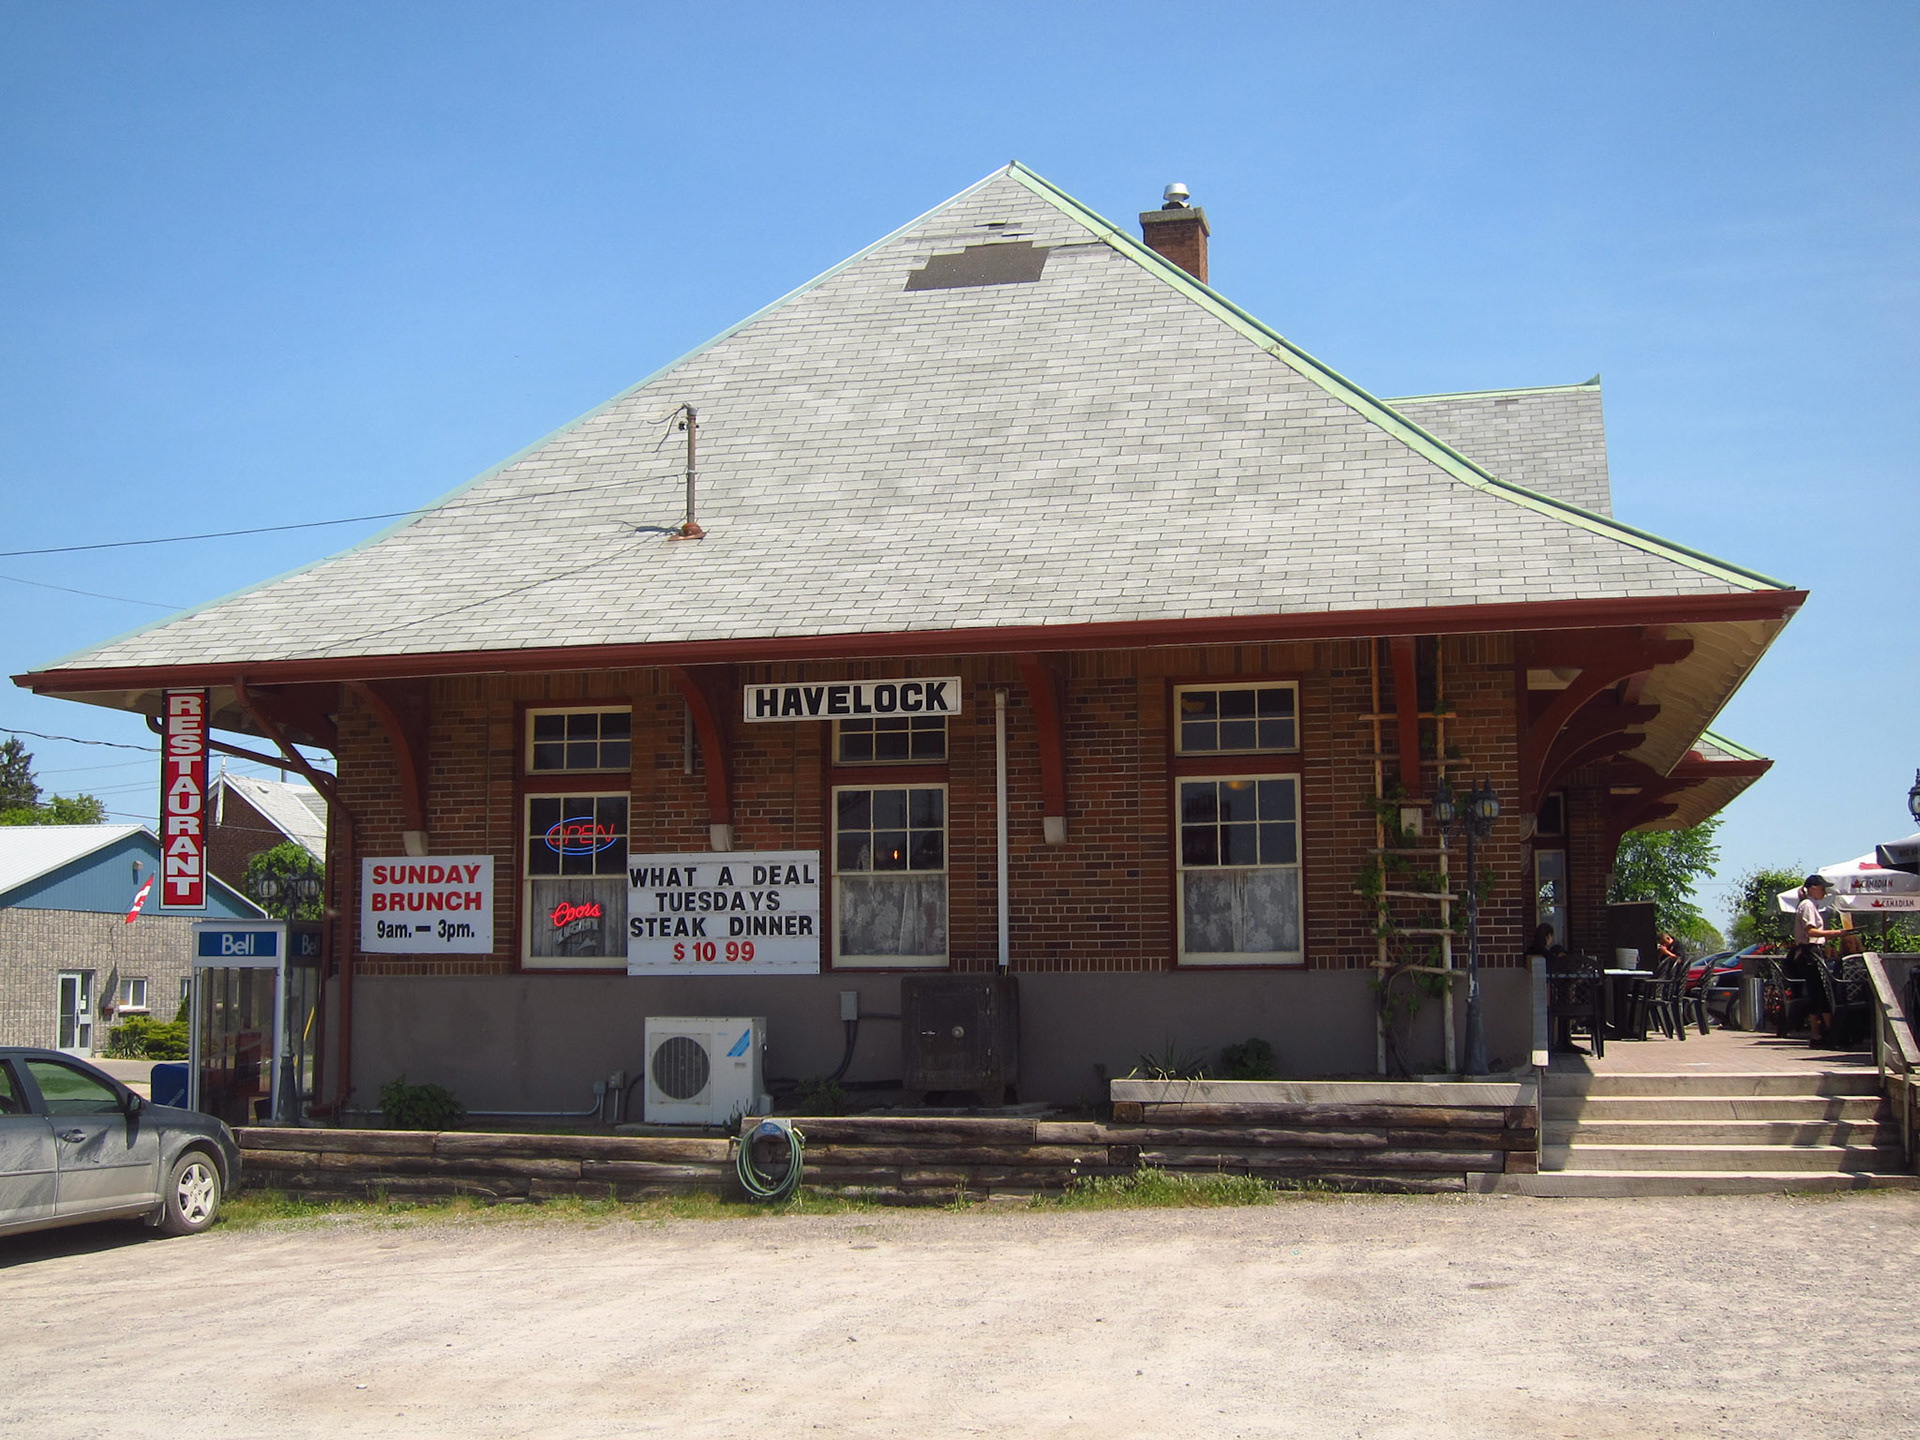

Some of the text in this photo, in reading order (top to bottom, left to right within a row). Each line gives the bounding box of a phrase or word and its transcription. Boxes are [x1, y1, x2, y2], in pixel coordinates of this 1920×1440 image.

[755, 682, 949, 717] HAVELOCK
[166, 696, 202, 896] RESTAURANT
[548, 824, 615, 846] OPEN
[372, 864, 481, 885] SUNDAY
[629, 864, 815, 888] WHAT A DEAL
[1861, 878, 1893, 889] CANADIAN
[371, 891, 482, 912] BRUNCH
[655, 890, 781, 912] TUESDAYS
[1881, 899, 1914, 908] CANADIAN
[550, 902, 603, 927] Coors
[376, 919, 412, 939] 9am.
[437, 919, 475, 942] 3pm.
[629, 915, 813, 938] STEAK DINNER
[221, 933, 255, 955] Bell
